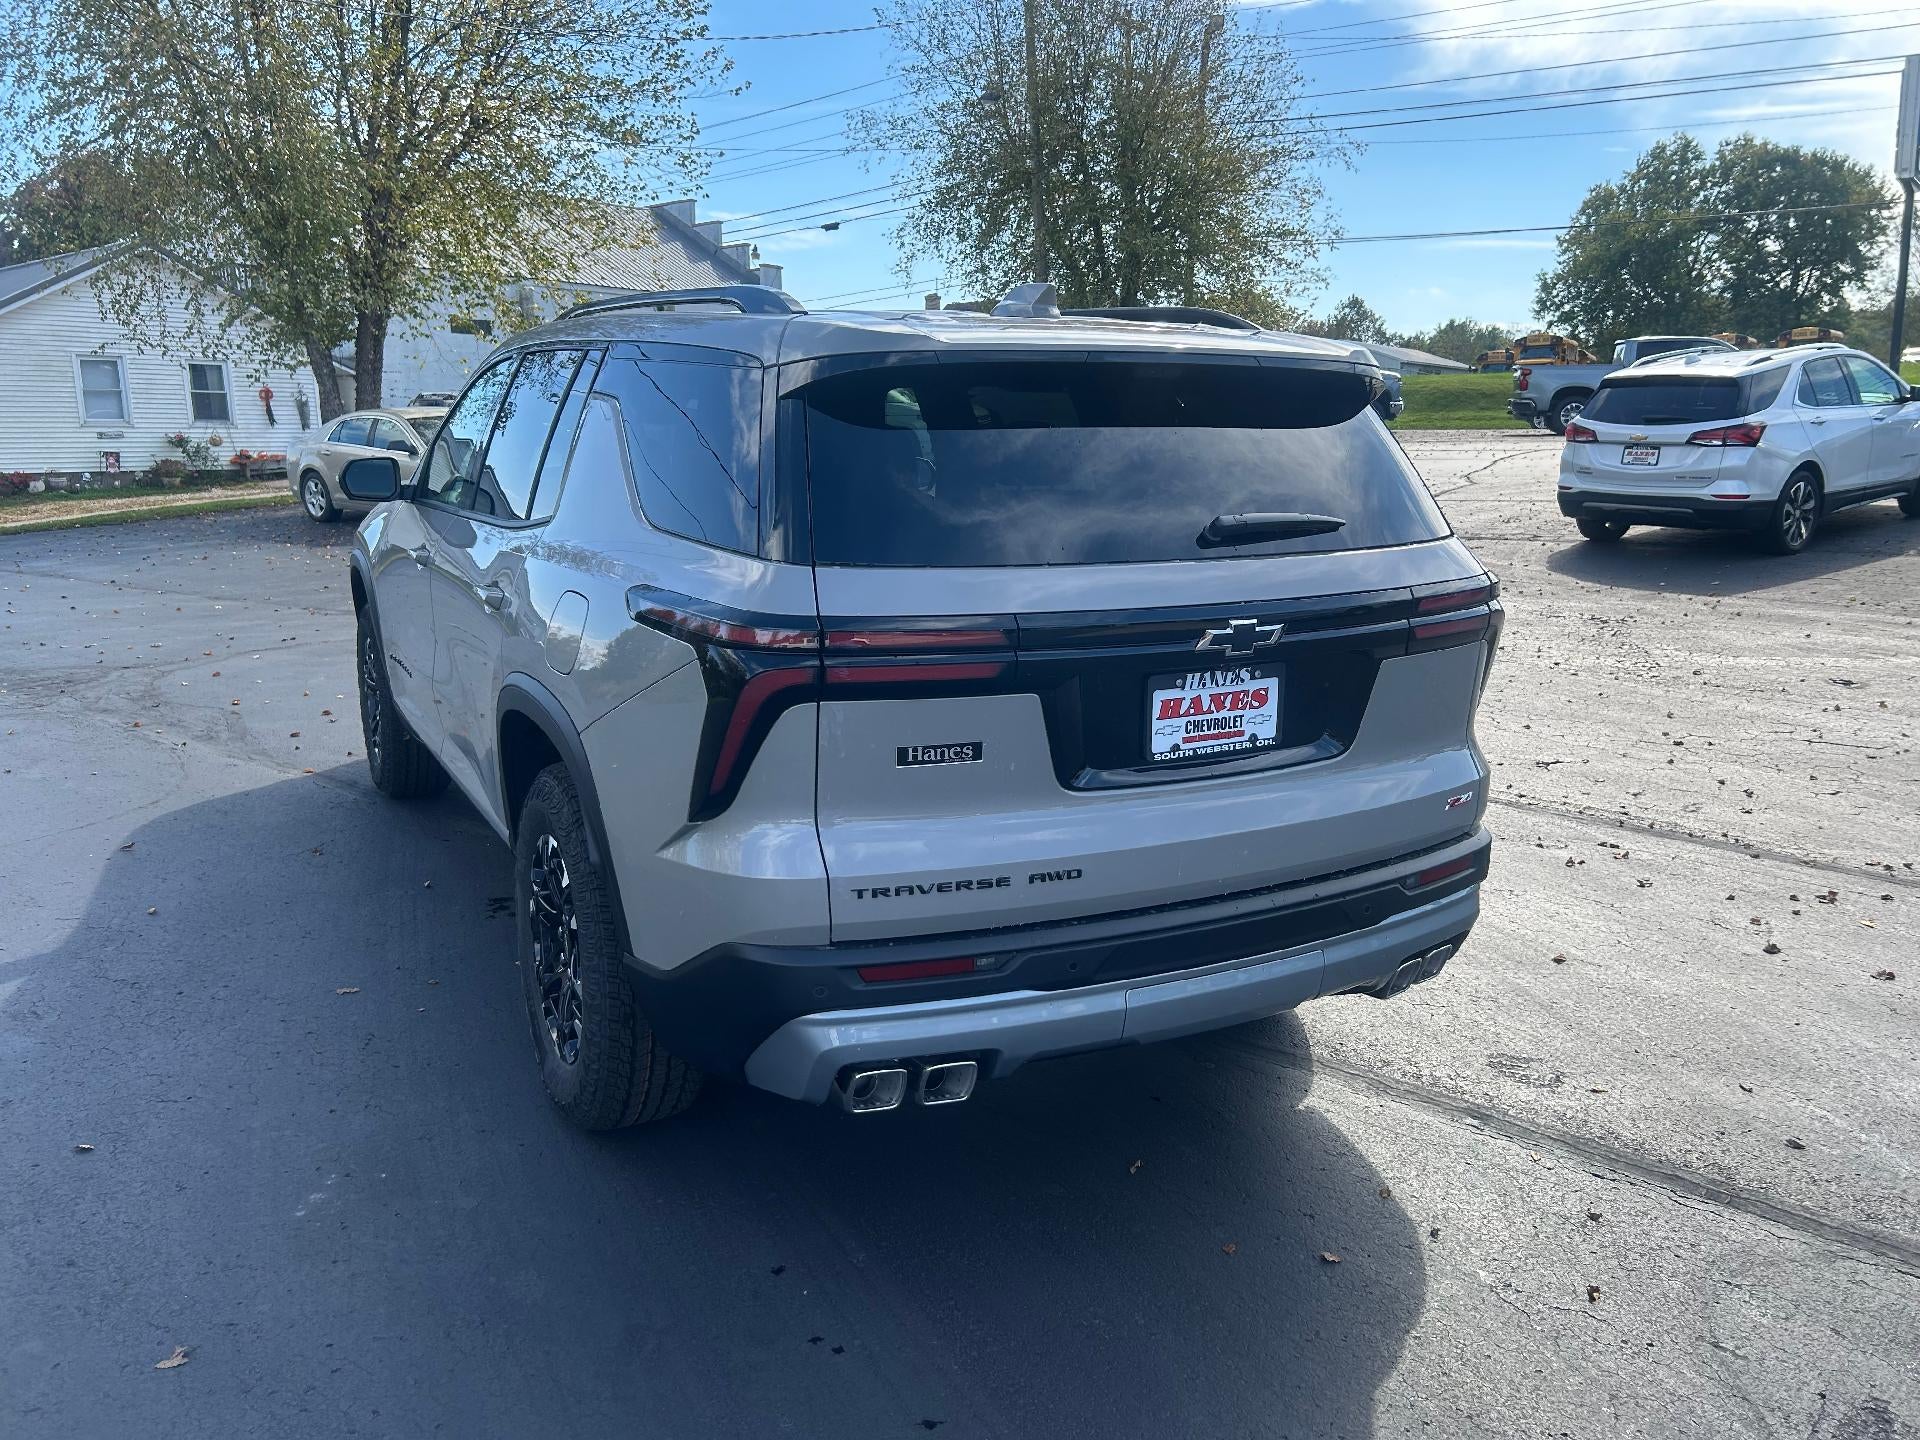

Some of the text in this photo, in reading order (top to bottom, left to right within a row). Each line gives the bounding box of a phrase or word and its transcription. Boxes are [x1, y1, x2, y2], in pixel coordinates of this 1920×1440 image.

[1184, 667, 1251, 690] HANES
[1156, 687, 1269, 720] HANES
[1185, 714, 1244, 734] CHEVROLET
[907, 745, 973, 762] Hanes
[1153, 748, 1194, 761] SOUTH
[1256, 738, 1276, 746] OH.
[851, 868, 1083, 899] TRAVERSE AWD
